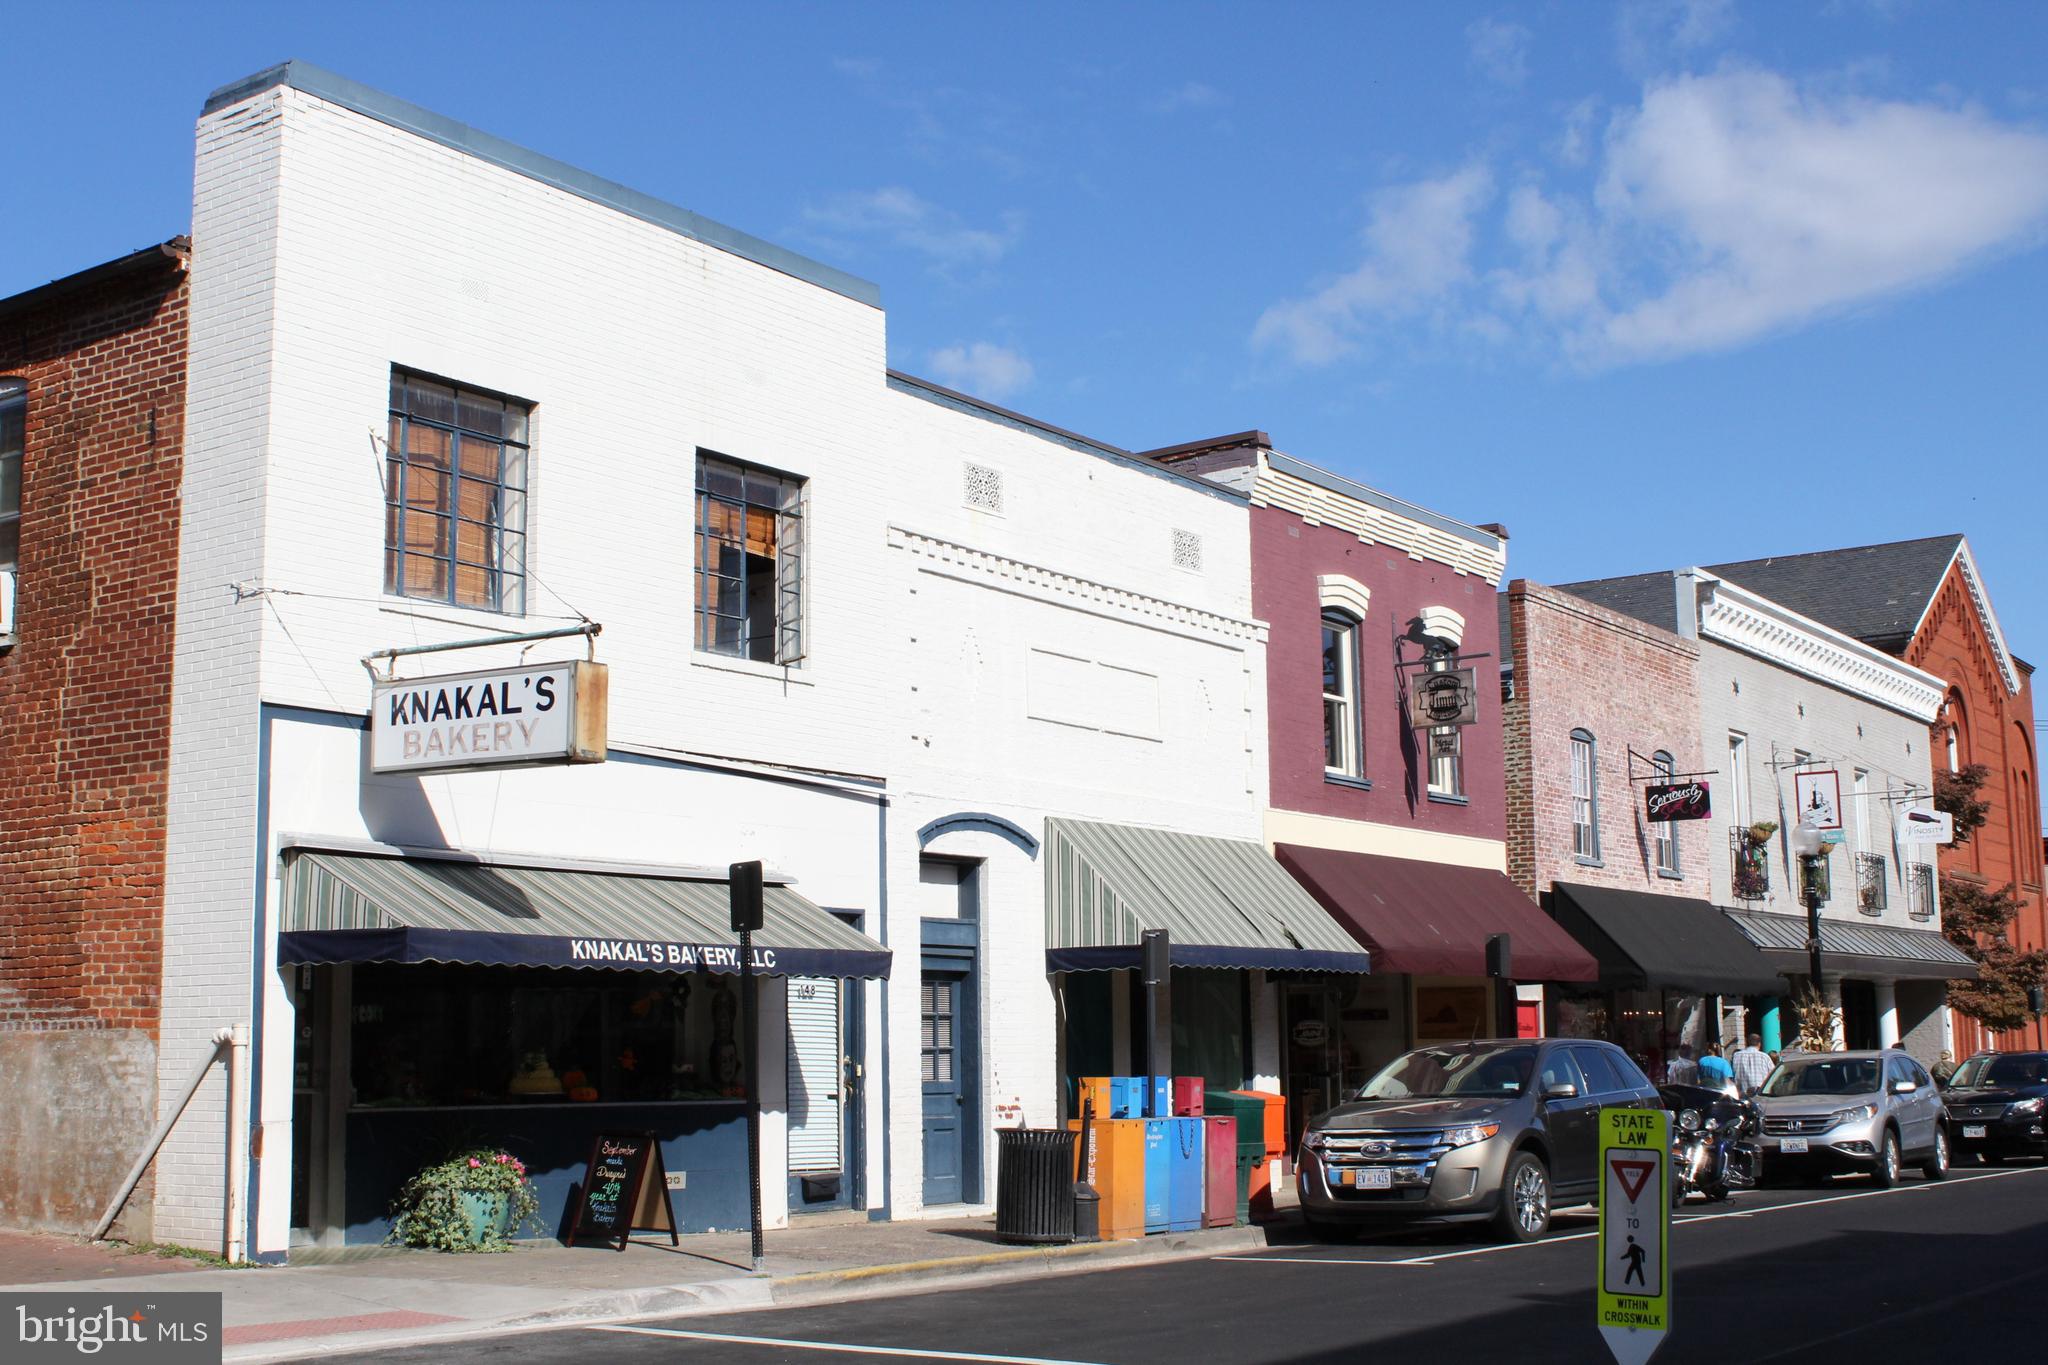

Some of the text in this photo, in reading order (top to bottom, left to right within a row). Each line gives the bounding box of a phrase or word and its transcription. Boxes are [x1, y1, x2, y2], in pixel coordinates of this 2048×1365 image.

[390, 675, 556, 727] KNAKAL'S
[403, 717, 540, 760] BAKERY
[1648, 784, 1703, 814] Seriously
[571, 939, 777, 970] KNAKAL'S BAKERY, LC
[800, 984, 816, 996] 148
[1611, 1114, 1654, 1130] STATE
[1618, 1131, 1647, 1145] LAW
[1625, 1217, 1640, 1229] TO
[1617, 1297, 1649, 1311] WITHIN
[1604, 1310, 1661, 1326] CROSSWALK
